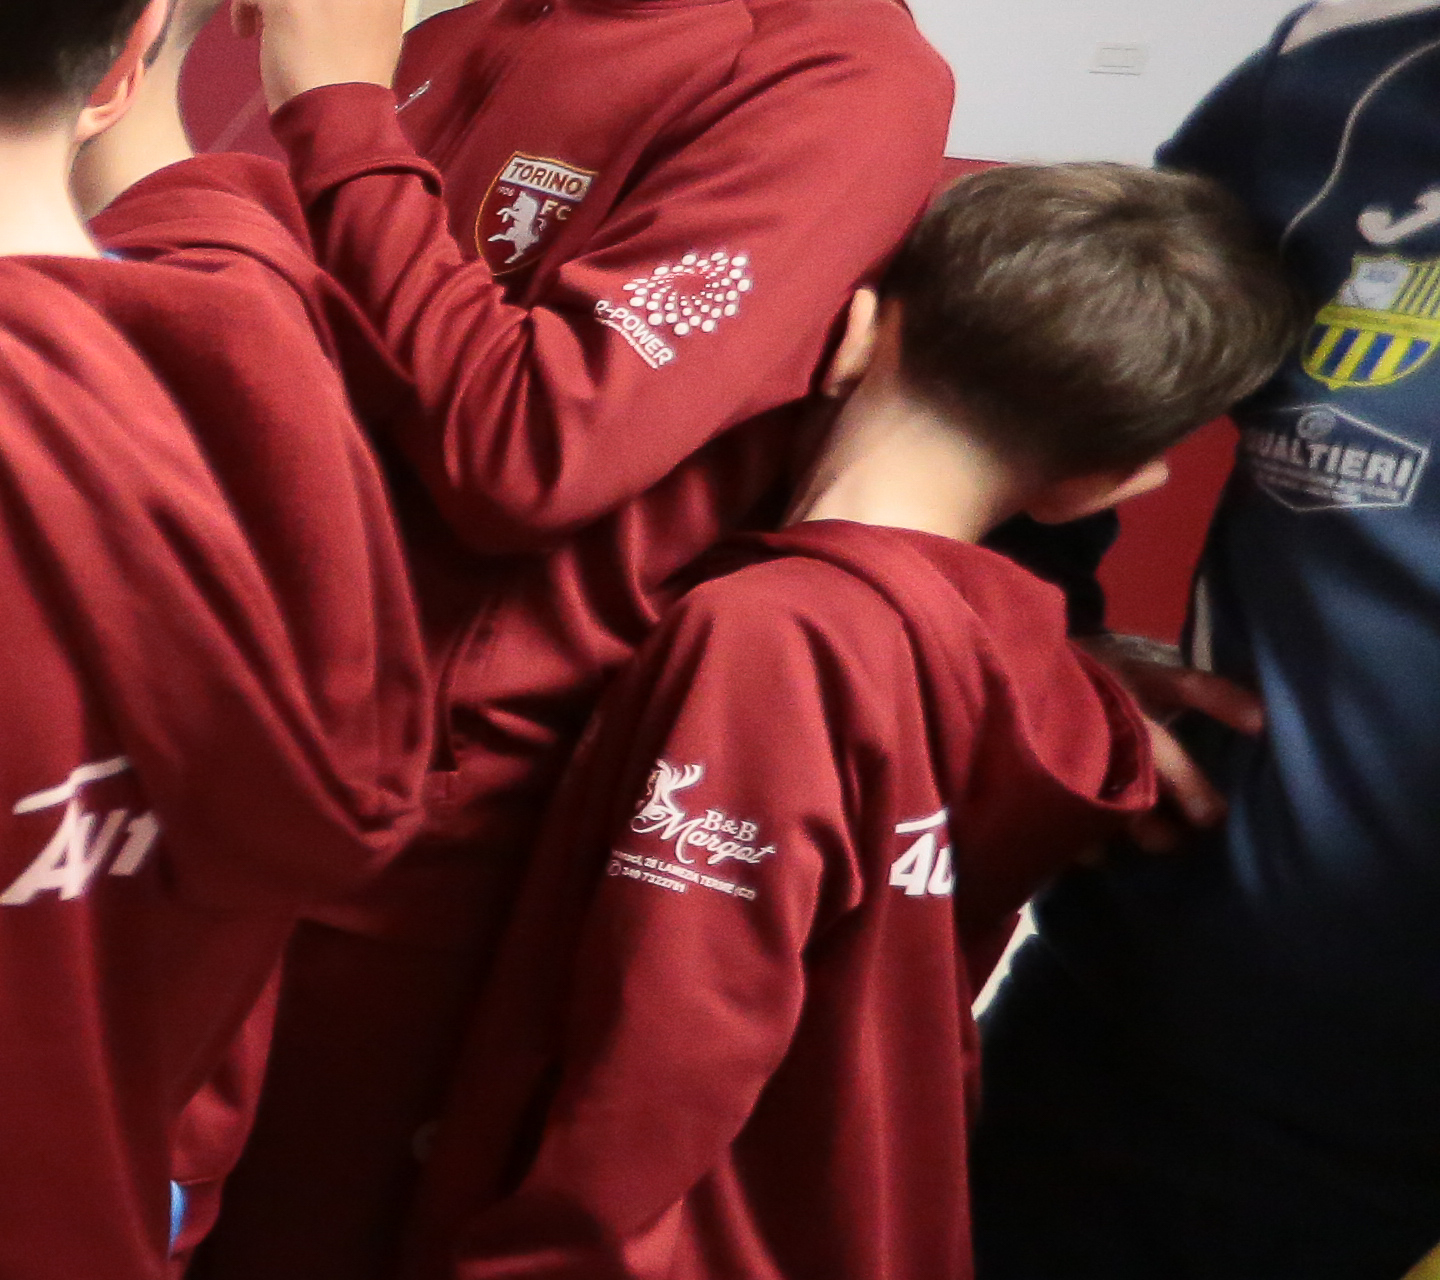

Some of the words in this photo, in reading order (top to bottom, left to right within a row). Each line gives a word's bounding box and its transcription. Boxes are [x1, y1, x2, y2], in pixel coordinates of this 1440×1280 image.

[508, 162, 582, 194] TORINO
[540, 199, 571, 220] FC
[631, 812, 777, 865] Margot
[701, 809, 758, 841] B&B
